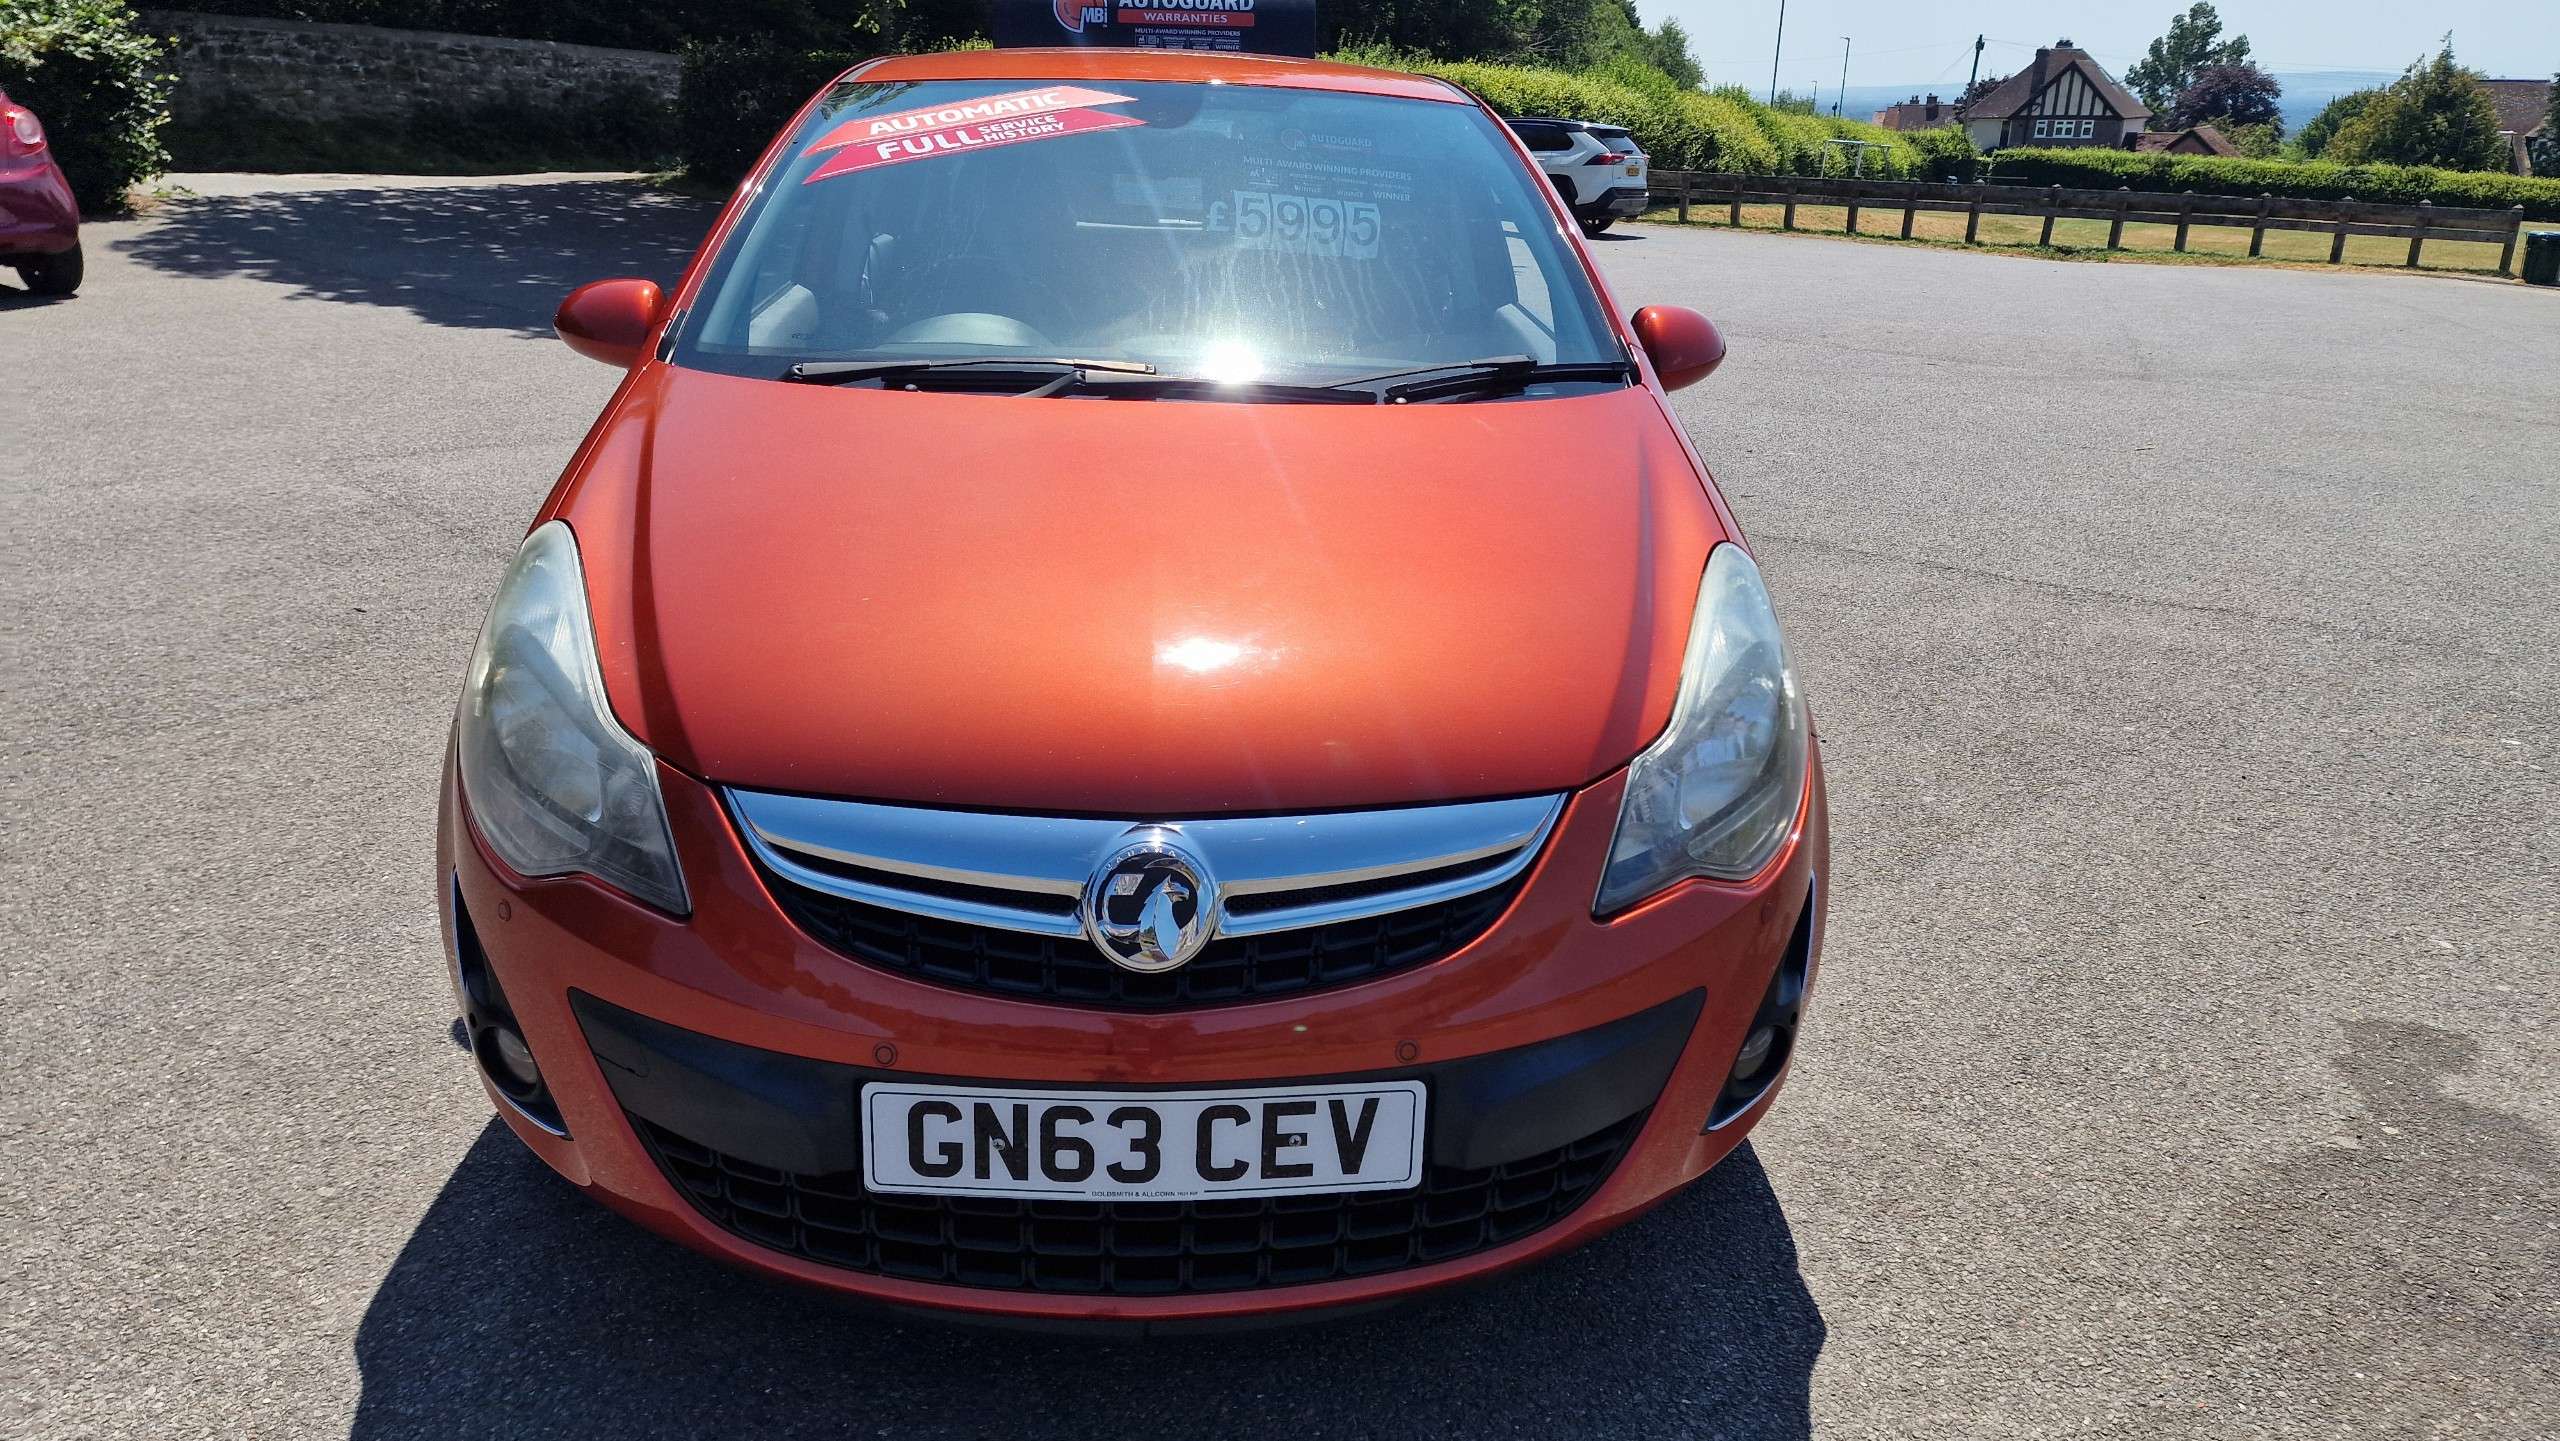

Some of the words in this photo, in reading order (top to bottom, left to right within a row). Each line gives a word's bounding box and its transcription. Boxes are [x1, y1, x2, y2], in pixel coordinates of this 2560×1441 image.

[1144, 12, 1228, 23] WARRANTIES
[869, 92, 1067, 136] AUTOMATIC
[978, 114, 1058, 135] SERVICE
[876, 130, 984, 160] FULL
[983, 121, 1065, 142] HISTORY
[1311, 133, 1372, 148] AUTOGUARD
[1313, 163, 1358, 177] WINNING
[1359, 168, 1412, 182] PROVIDERS
[1373, 190, 1411, 201] WINNER
[907, 1100, 1162, 1184] GN63
[1195, 1097, 1381, 1182] CEV
